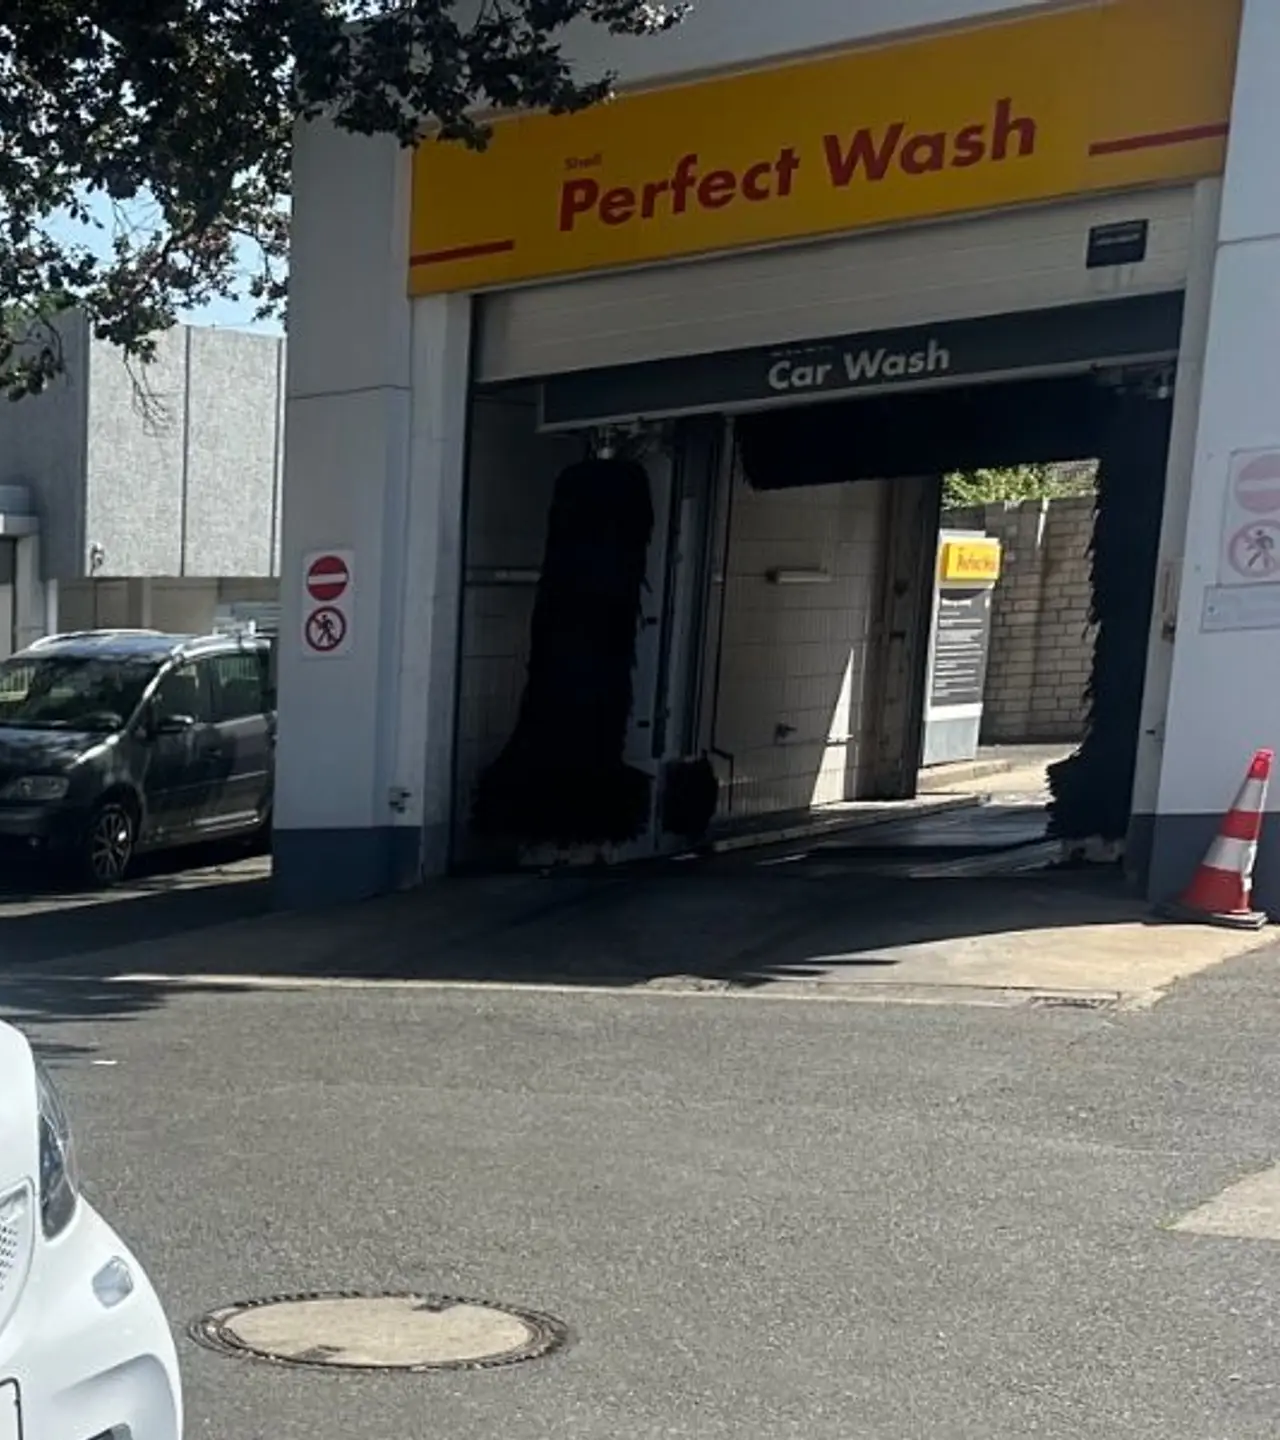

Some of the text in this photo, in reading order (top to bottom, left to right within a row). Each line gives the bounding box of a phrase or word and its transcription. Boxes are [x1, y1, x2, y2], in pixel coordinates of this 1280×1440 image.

[559, 97, 1037, 232] Perfect Wash
[768, 338, 950, 390] Car Wash
